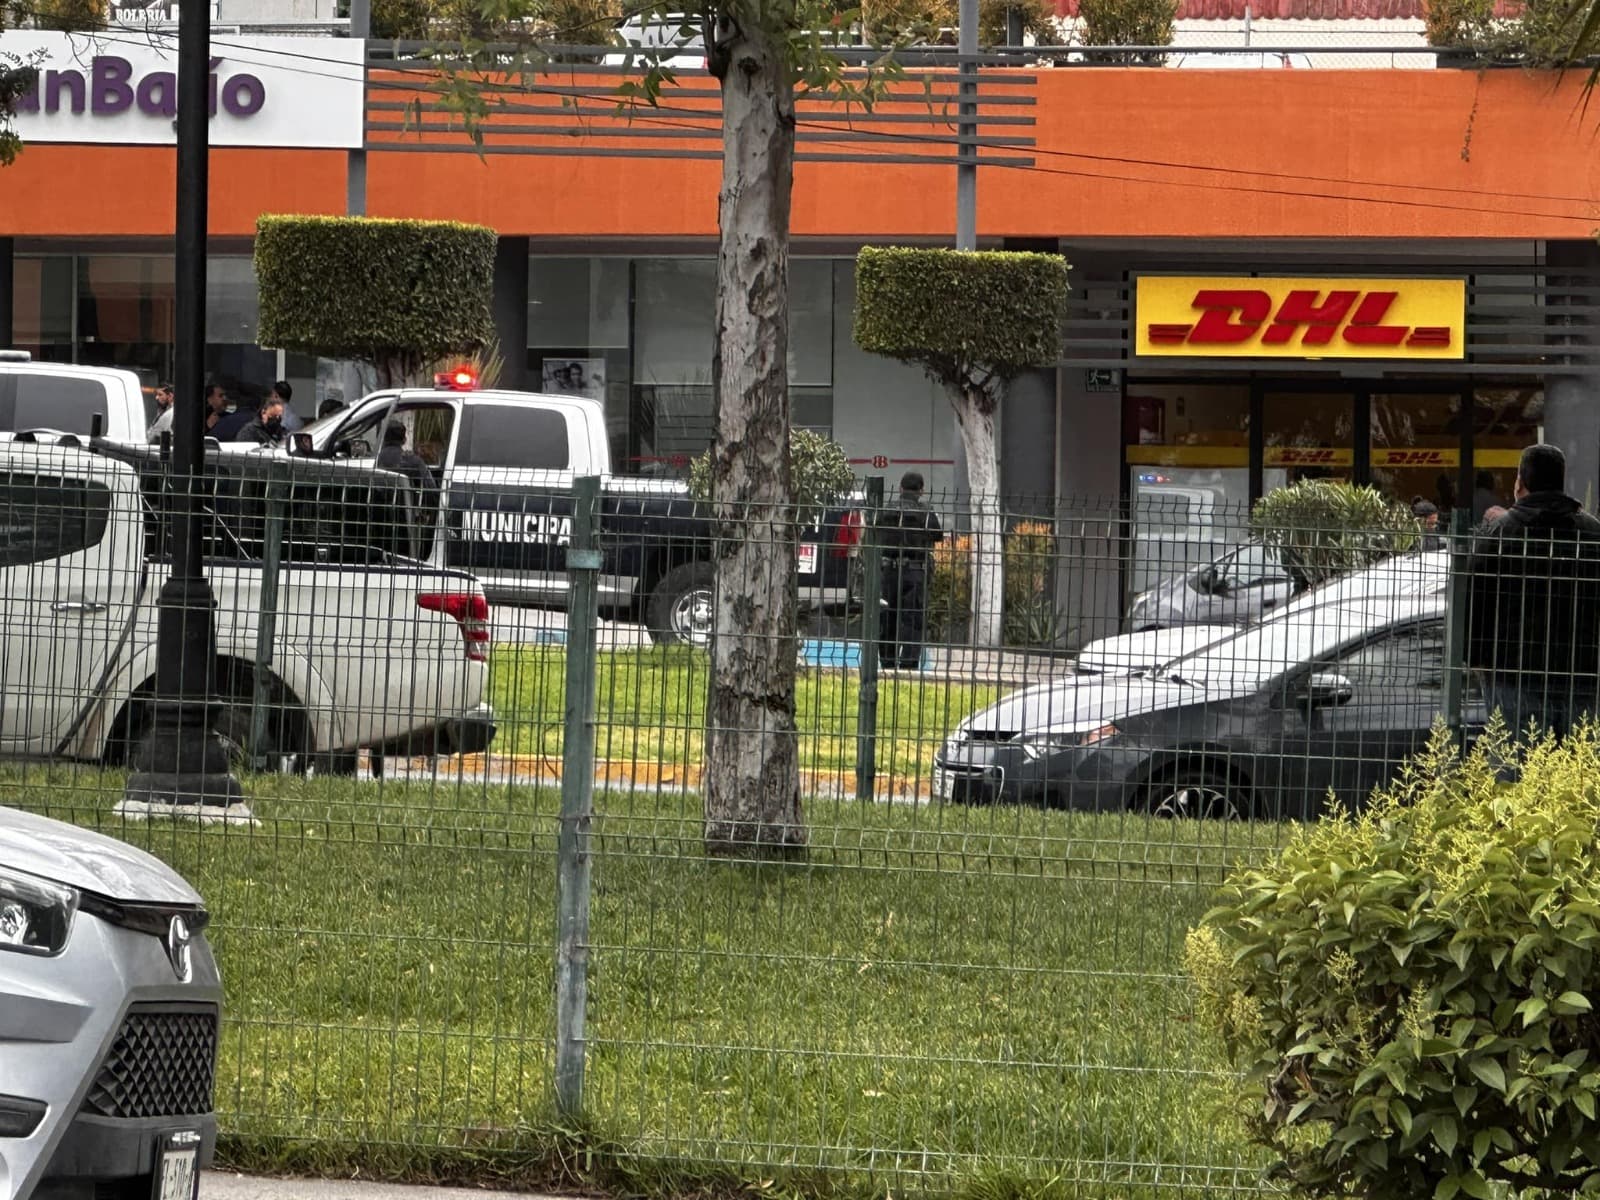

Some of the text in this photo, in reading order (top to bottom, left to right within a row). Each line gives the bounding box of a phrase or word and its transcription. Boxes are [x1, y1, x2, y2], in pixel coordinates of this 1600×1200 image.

[1187, 289, 1411, 345] DHL
[1280, 450, 1337, 463] DHL
[1386, 451, 1444, 465] DHL
[461, 510, 572, 547] MUNICIPA
